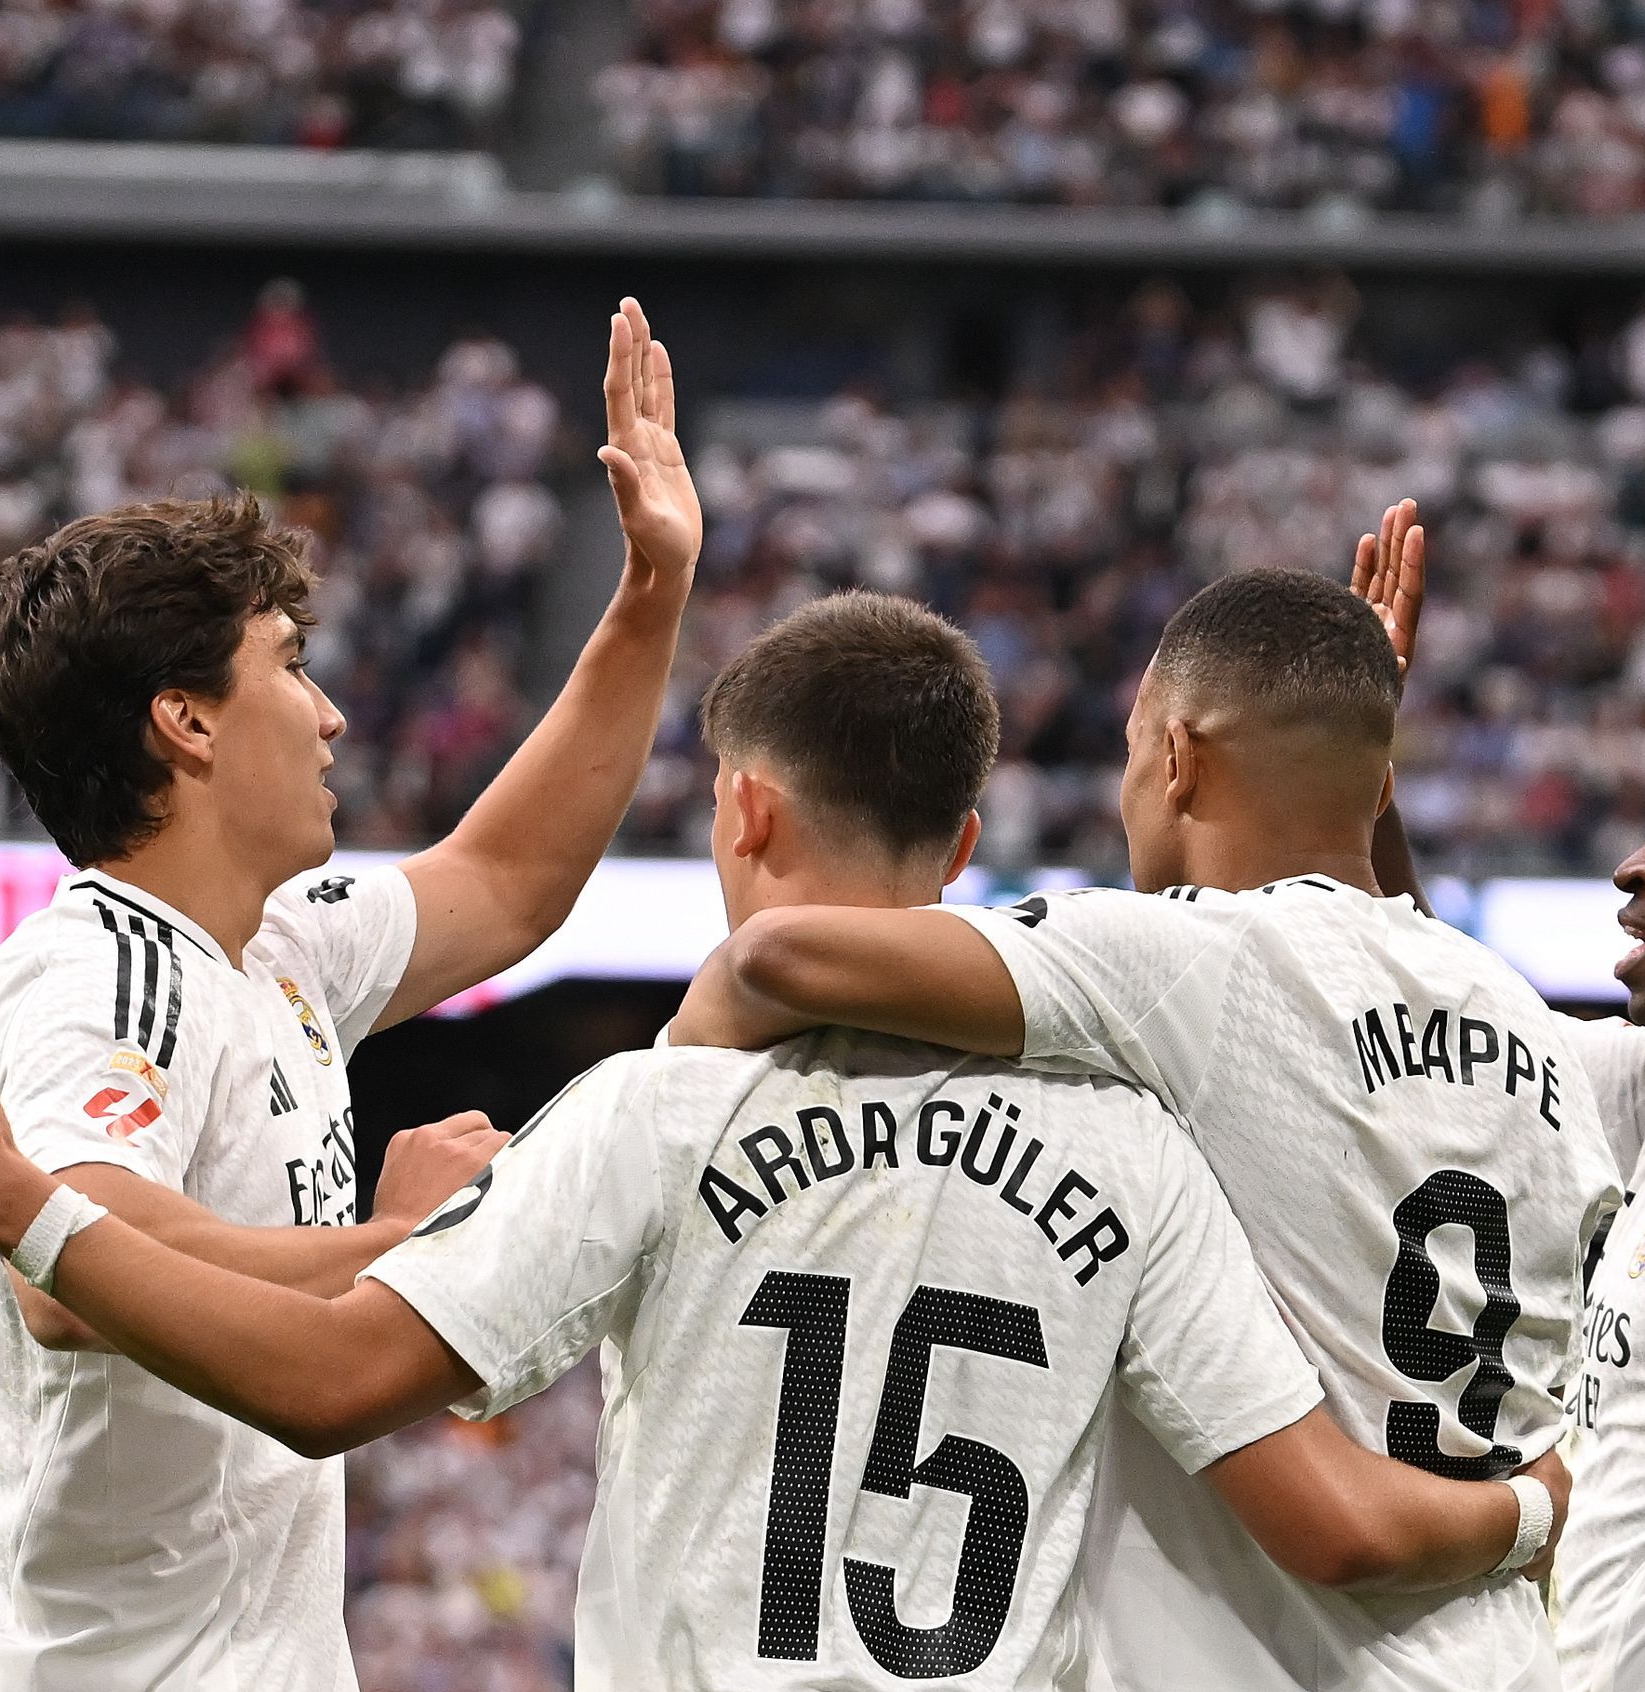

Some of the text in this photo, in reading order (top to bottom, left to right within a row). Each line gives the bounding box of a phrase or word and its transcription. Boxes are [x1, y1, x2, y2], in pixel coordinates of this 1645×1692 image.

[698, 1093, 1130, 1287] ARDA GÜLER
[1382, 1169, 1522, 1481] 9
[737, 1270, 1050, 1679] 15
